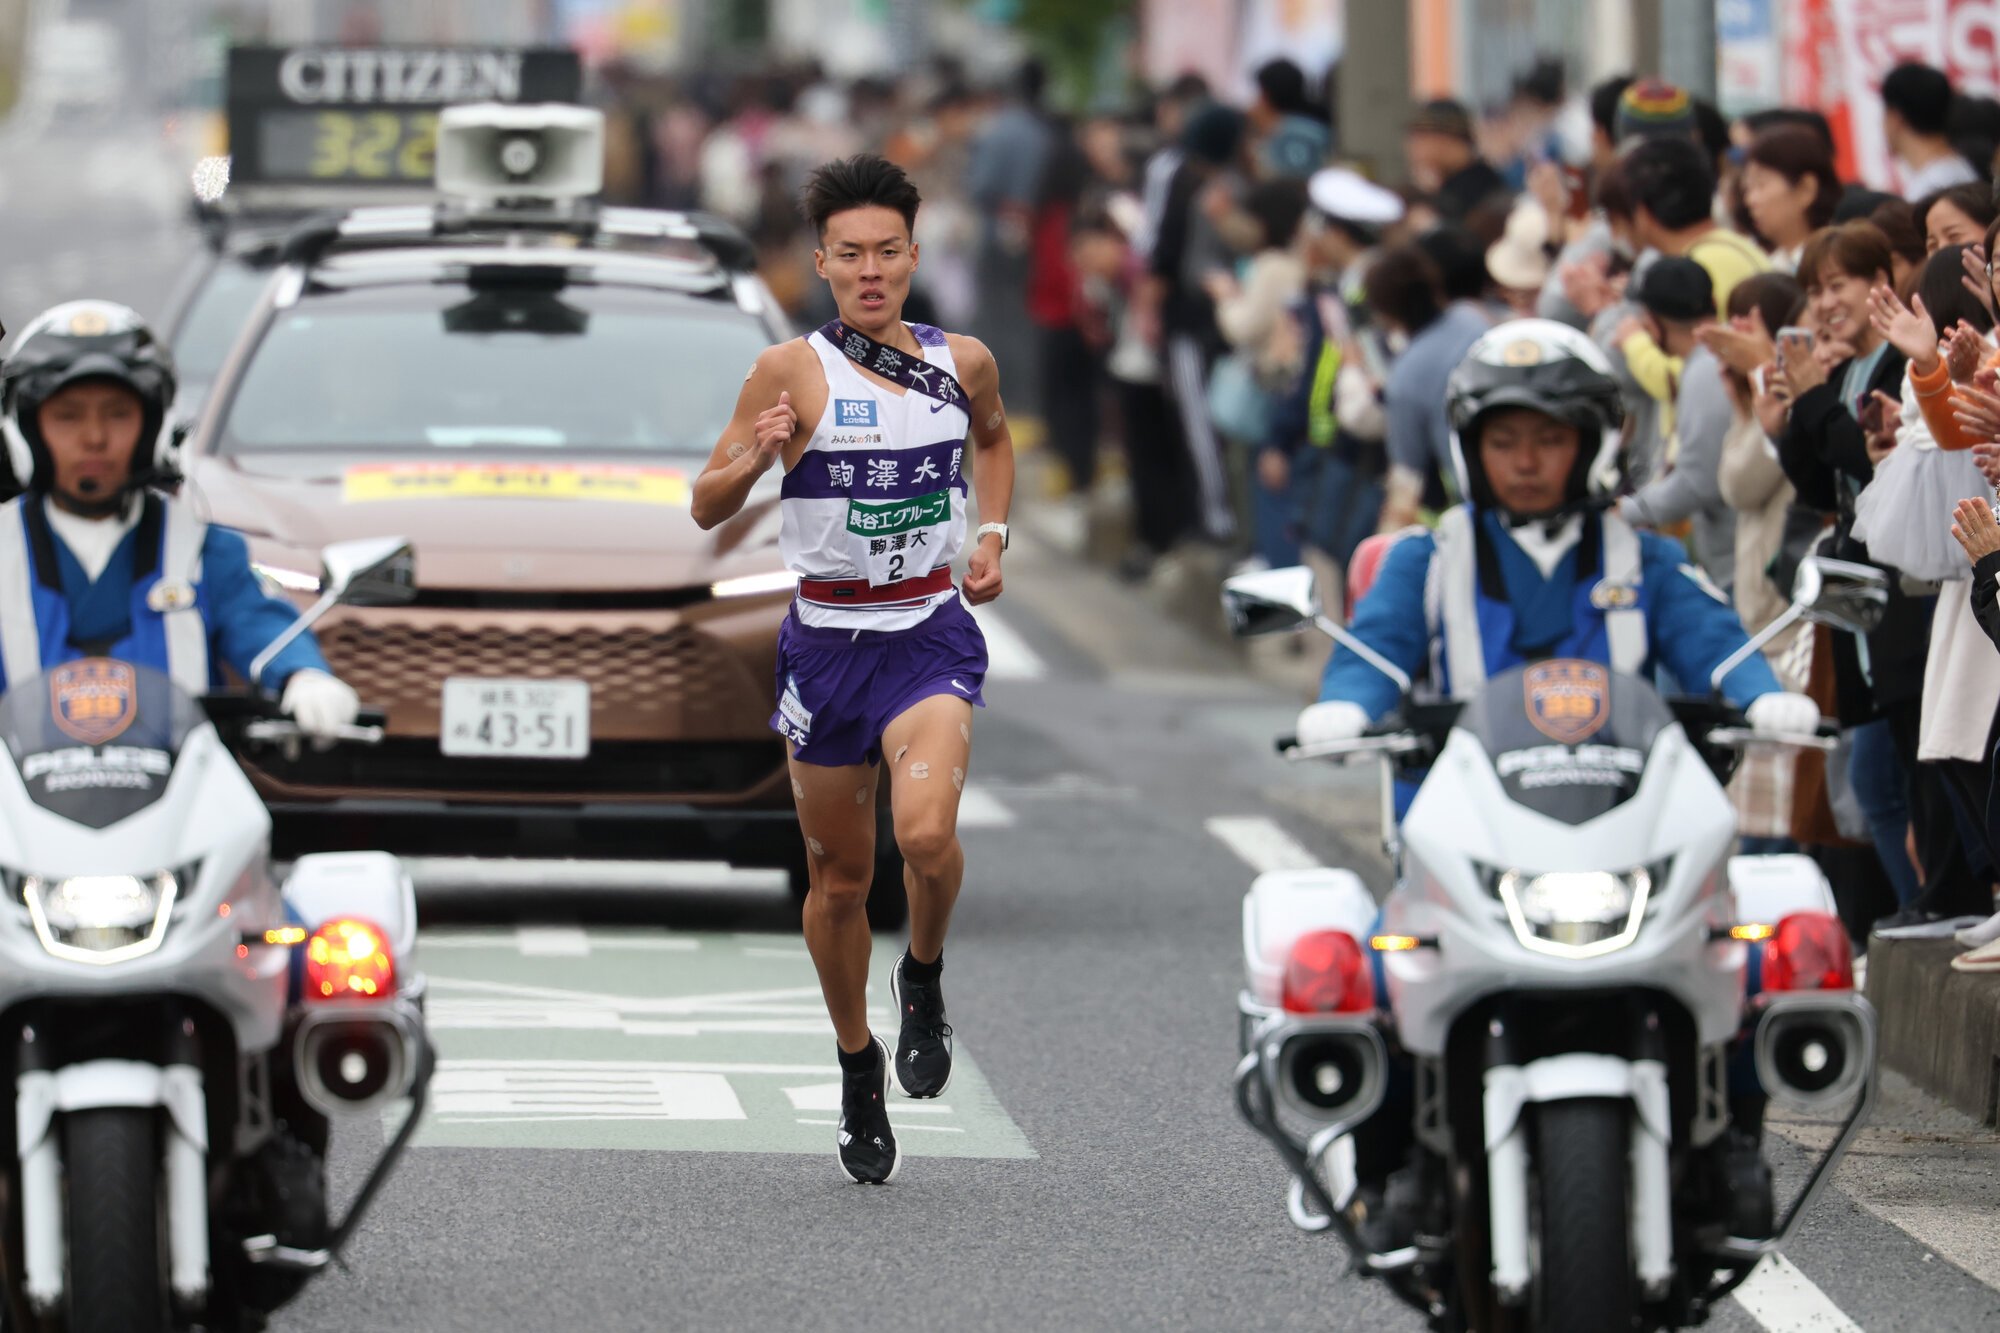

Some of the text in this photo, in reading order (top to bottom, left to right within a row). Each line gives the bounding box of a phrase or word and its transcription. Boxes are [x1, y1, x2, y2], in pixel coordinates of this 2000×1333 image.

[279, 49, 521, 103] CITIZEN
[841, 401, 870, 417] HRS
[830, 433, 882, 444] みんなの介護
[868, 529, 929, 557] 駒澤大
[887, 553, 905, 582] 2
